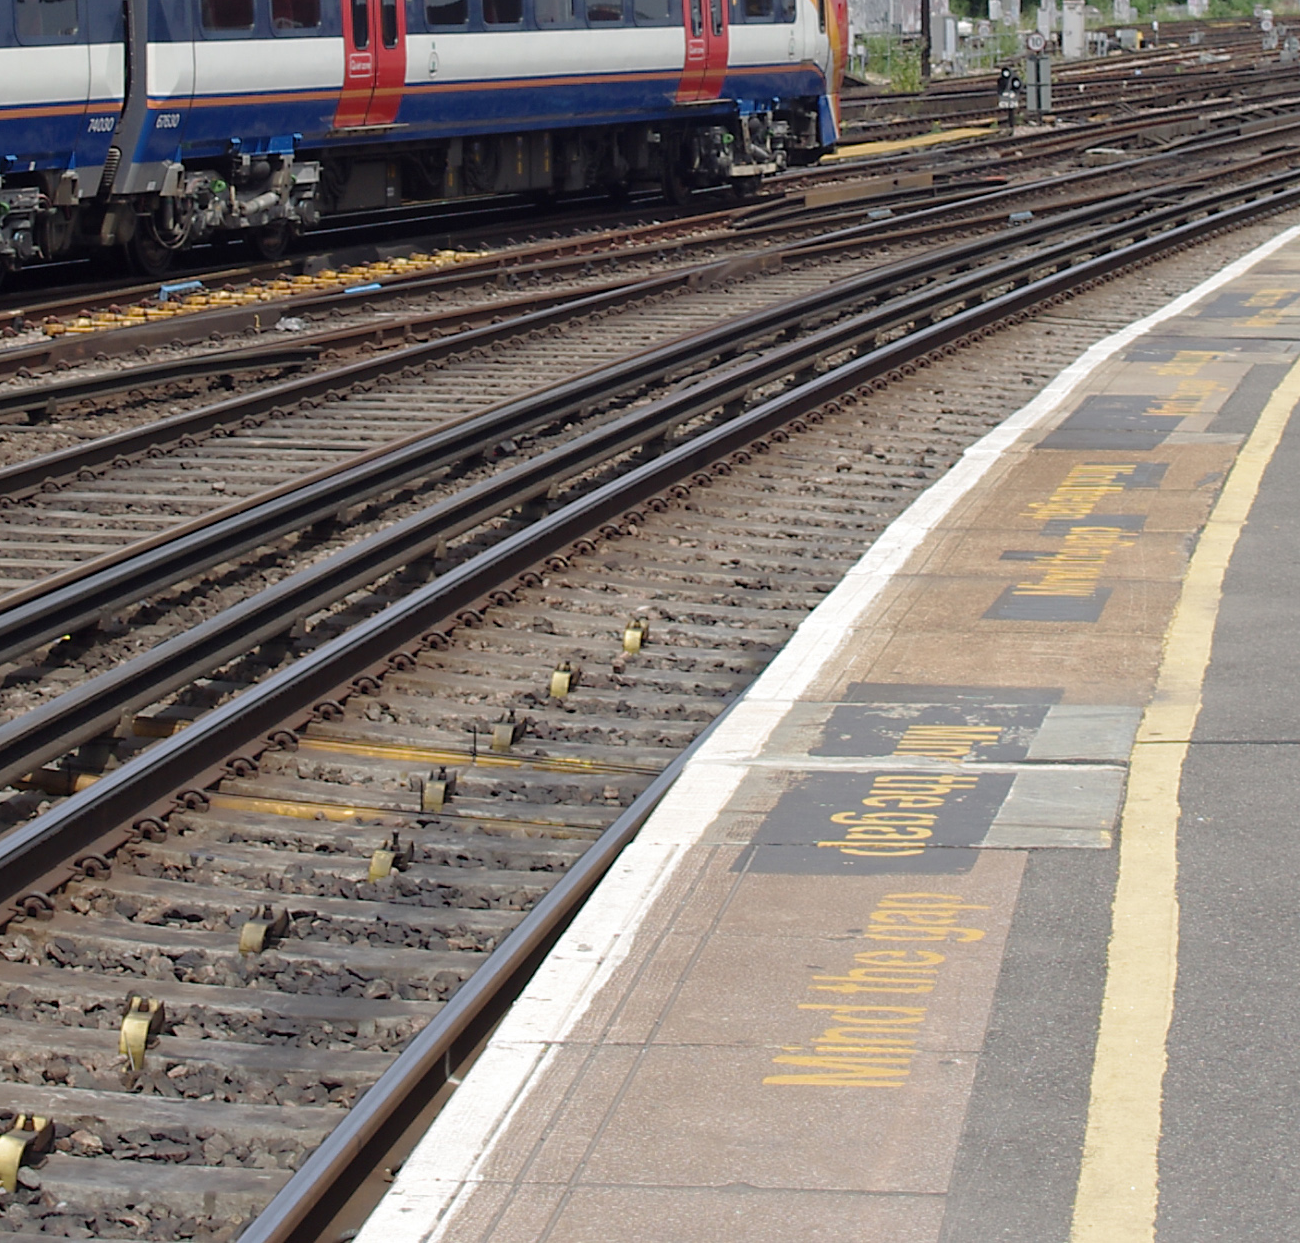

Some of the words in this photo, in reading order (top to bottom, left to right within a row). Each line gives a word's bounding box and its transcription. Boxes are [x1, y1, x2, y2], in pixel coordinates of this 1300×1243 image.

[1031, 36, 1042, 47] 10
[862, 774, 979, 809] the
[817, 811, 939, 857] gap
[864, 891, 993, 943] gap
[807, 949, 946, 994] the
[762, 1003, 928, 1088] Mind
